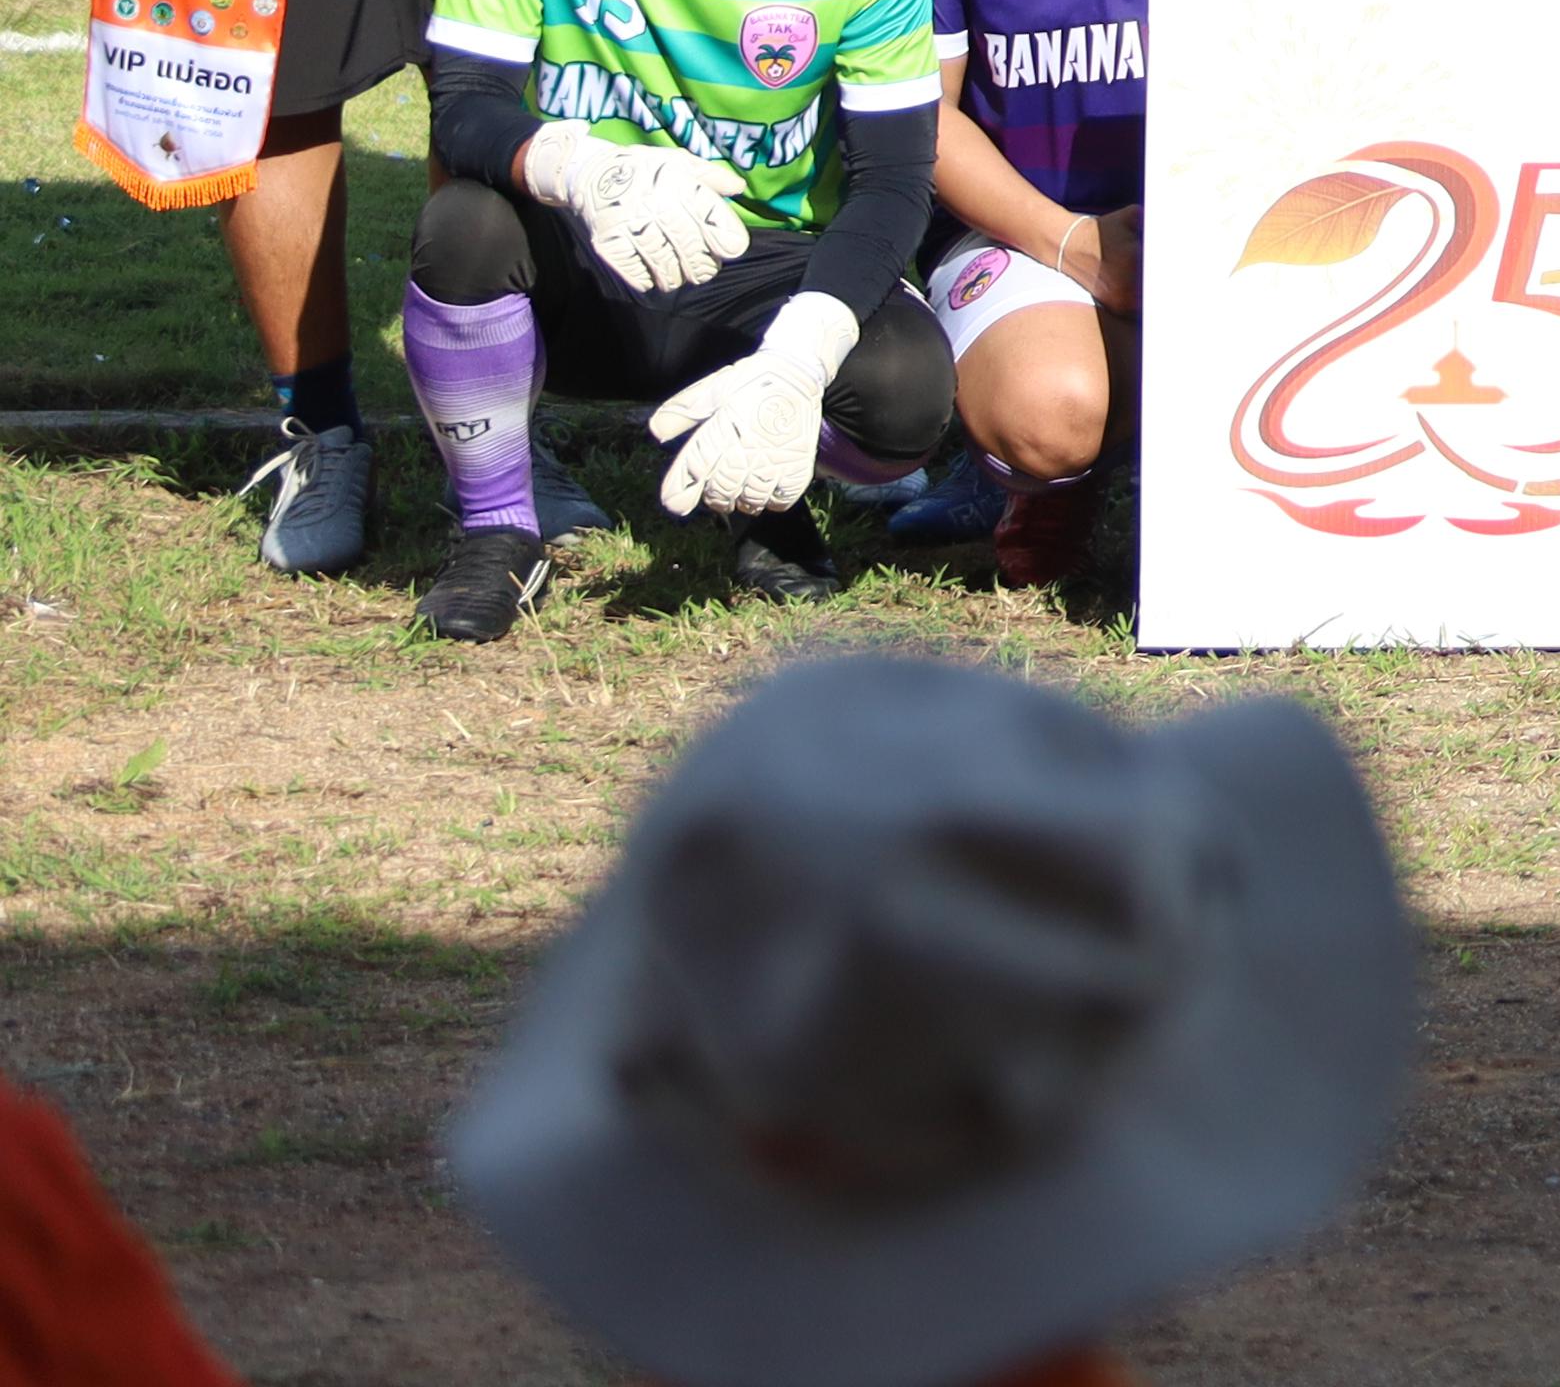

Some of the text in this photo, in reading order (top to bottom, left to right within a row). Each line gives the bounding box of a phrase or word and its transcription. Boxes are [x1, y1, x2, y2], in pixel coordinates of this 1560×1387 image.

[768, 23, 792, 34] TAK
[983, 20, 1144, 89] BANANA
[103, 41, 252, 95] VIP แม่สอด
